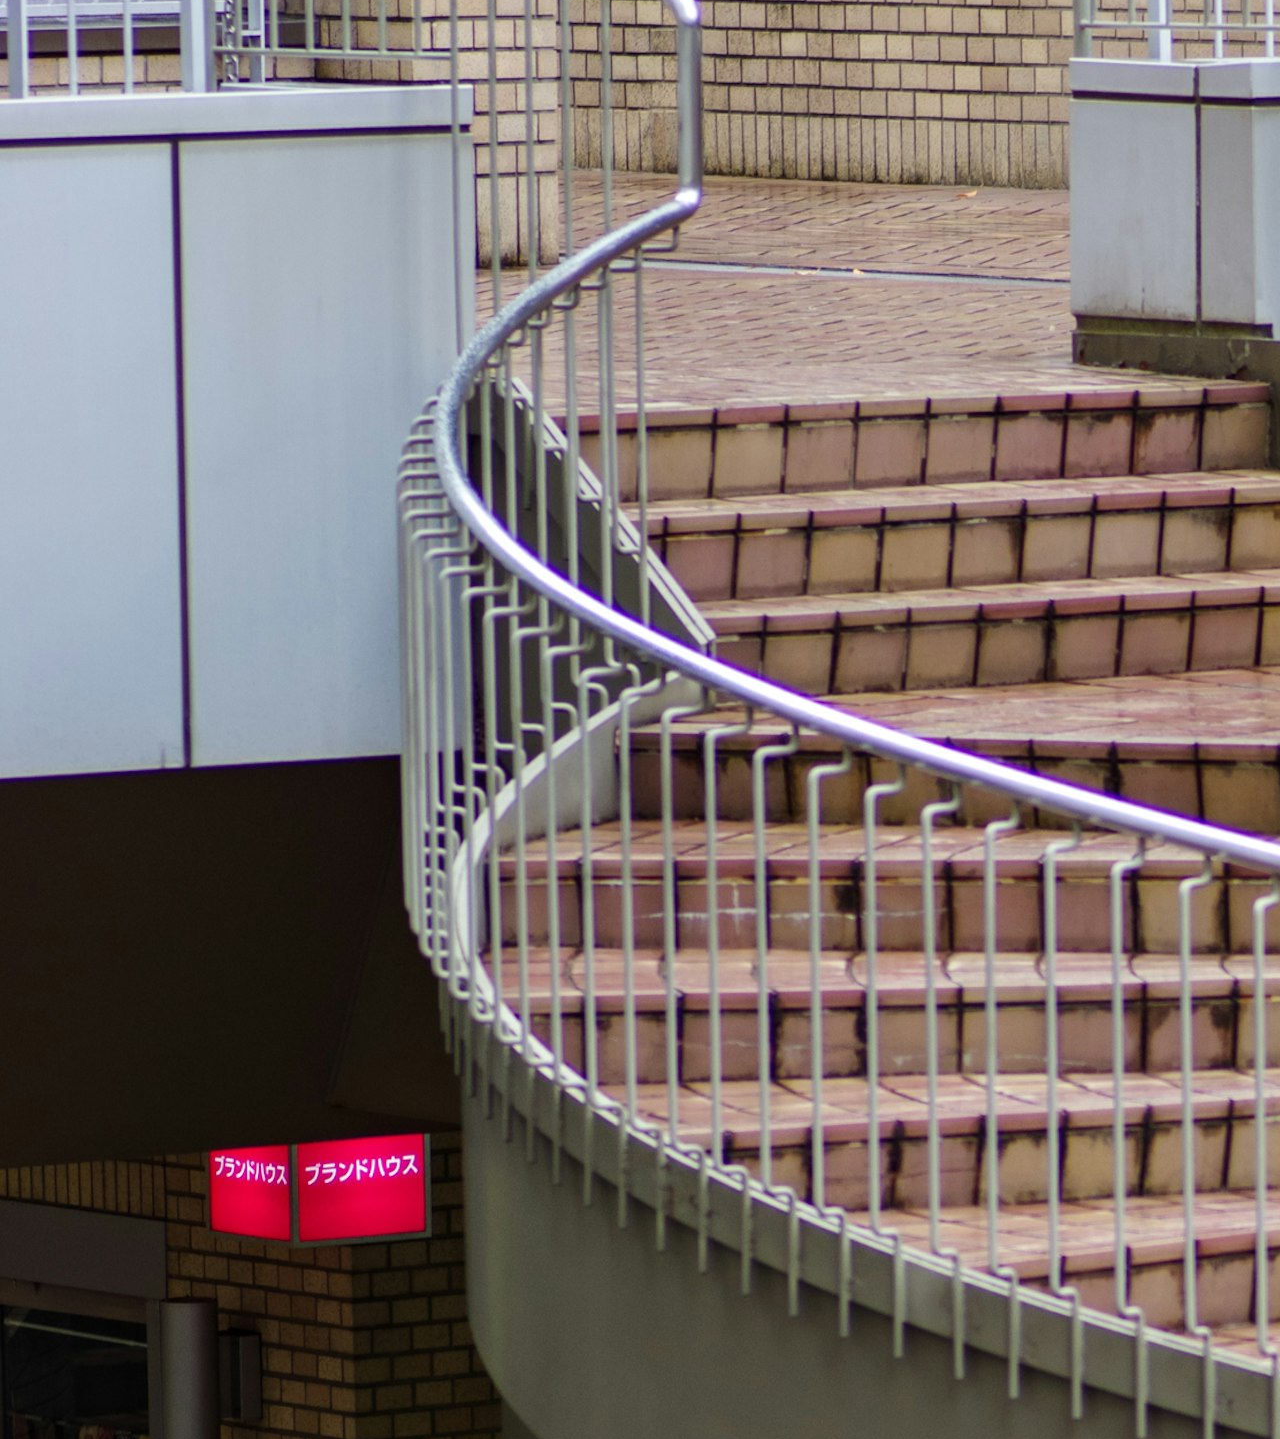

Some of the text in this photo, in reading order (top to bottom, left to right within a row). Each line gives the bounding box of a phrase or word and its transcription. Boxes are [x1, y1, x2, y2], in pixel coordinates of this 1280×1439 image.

[214, 1155, 288, 1185] ブランドハウス
[304, 1154, 419, 1186] ブランドハウス
